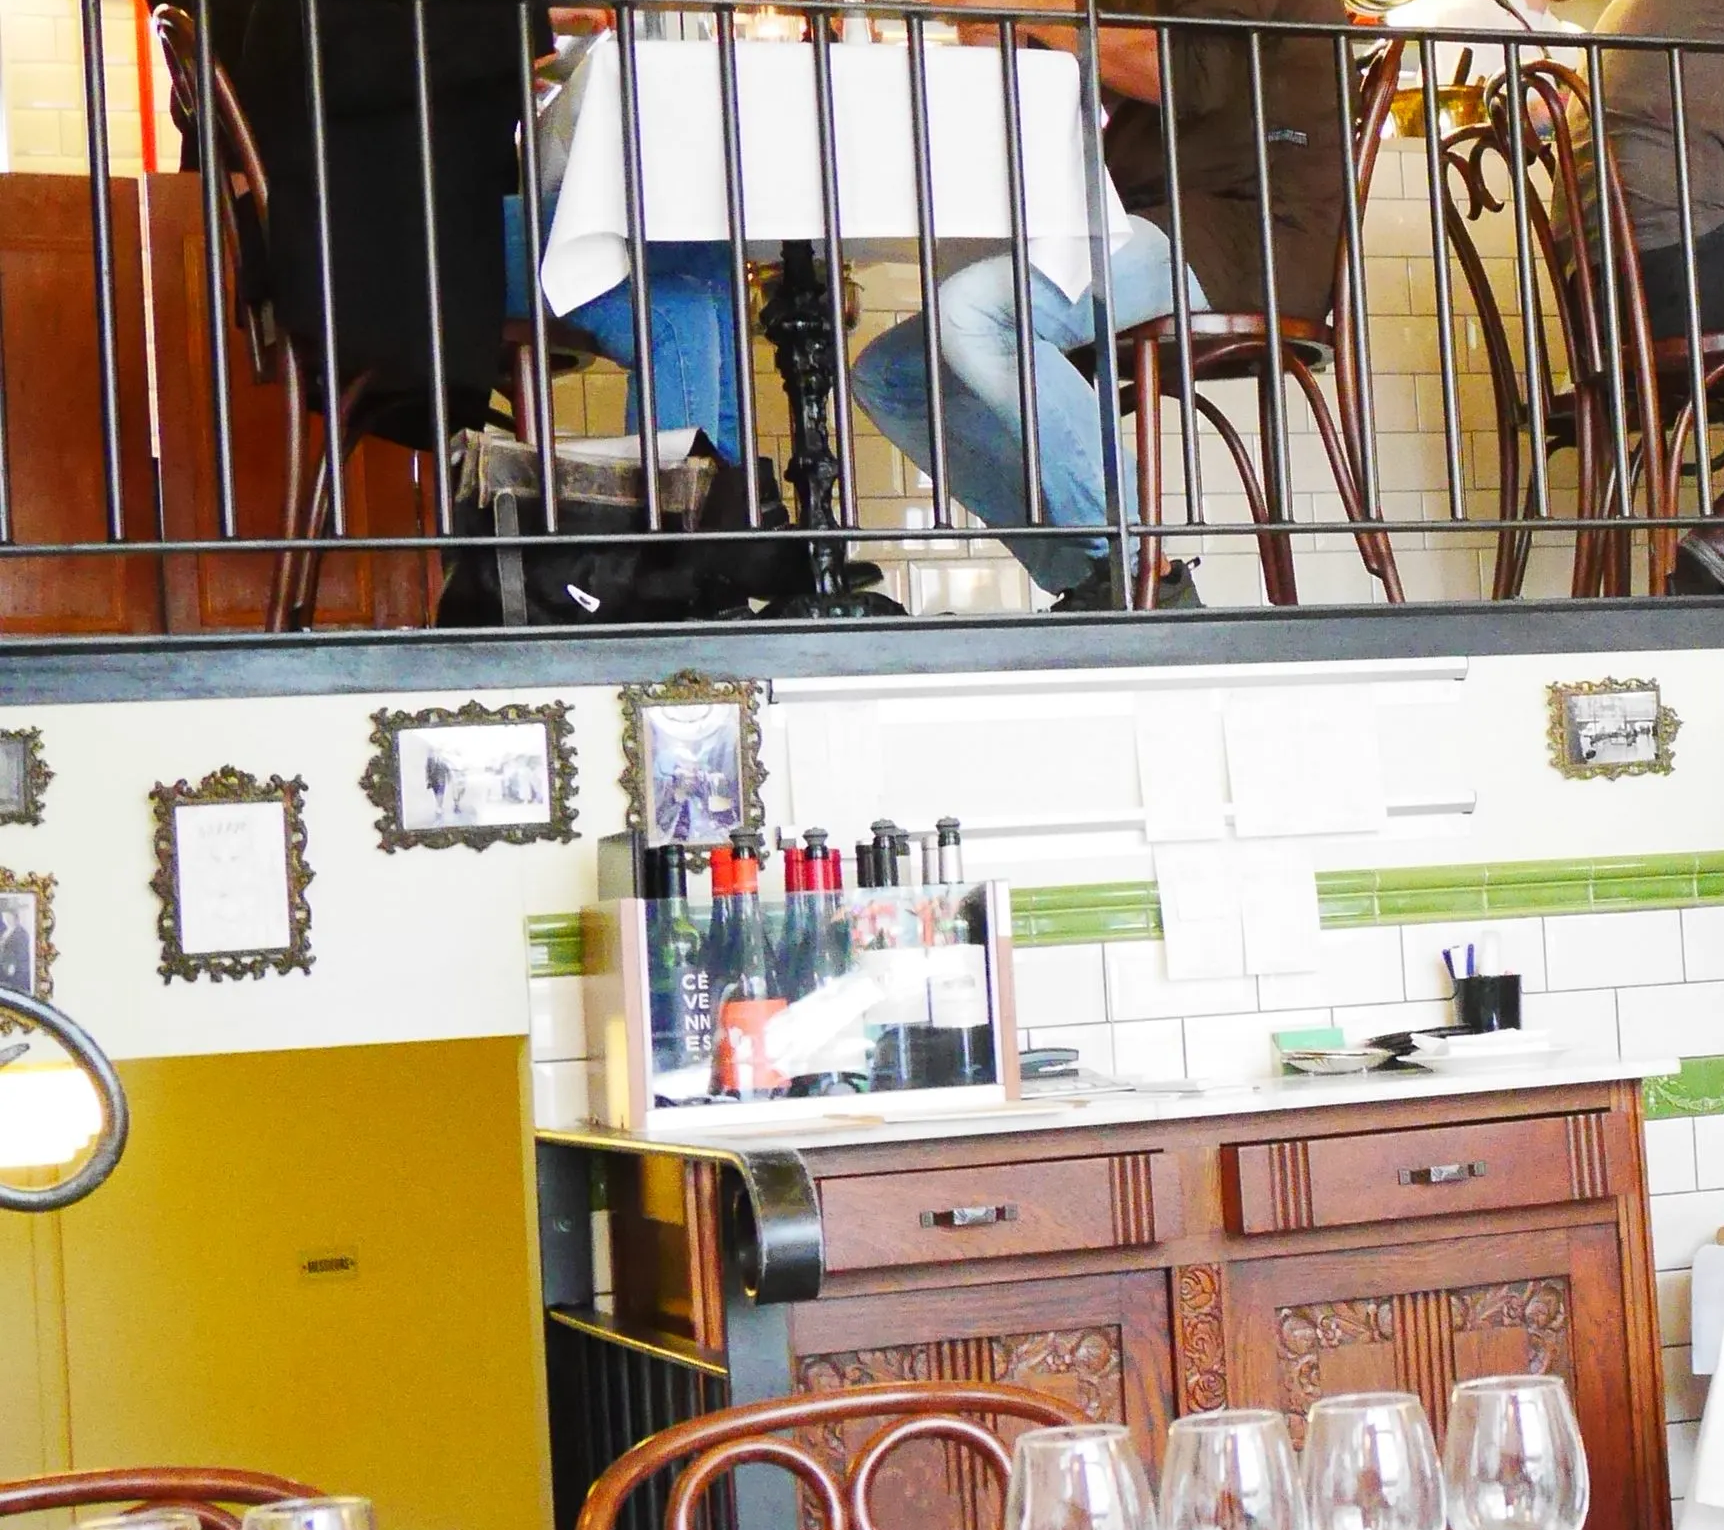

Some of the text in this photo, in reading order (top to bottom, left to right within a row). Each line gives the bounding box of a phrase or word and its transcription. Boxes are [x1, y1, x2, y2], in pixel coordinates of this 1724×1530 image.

[683, 992, 710, 1010] VE
[685, 1014, 711, 1031] NN
[686, 1035, 712, 1051] ES
